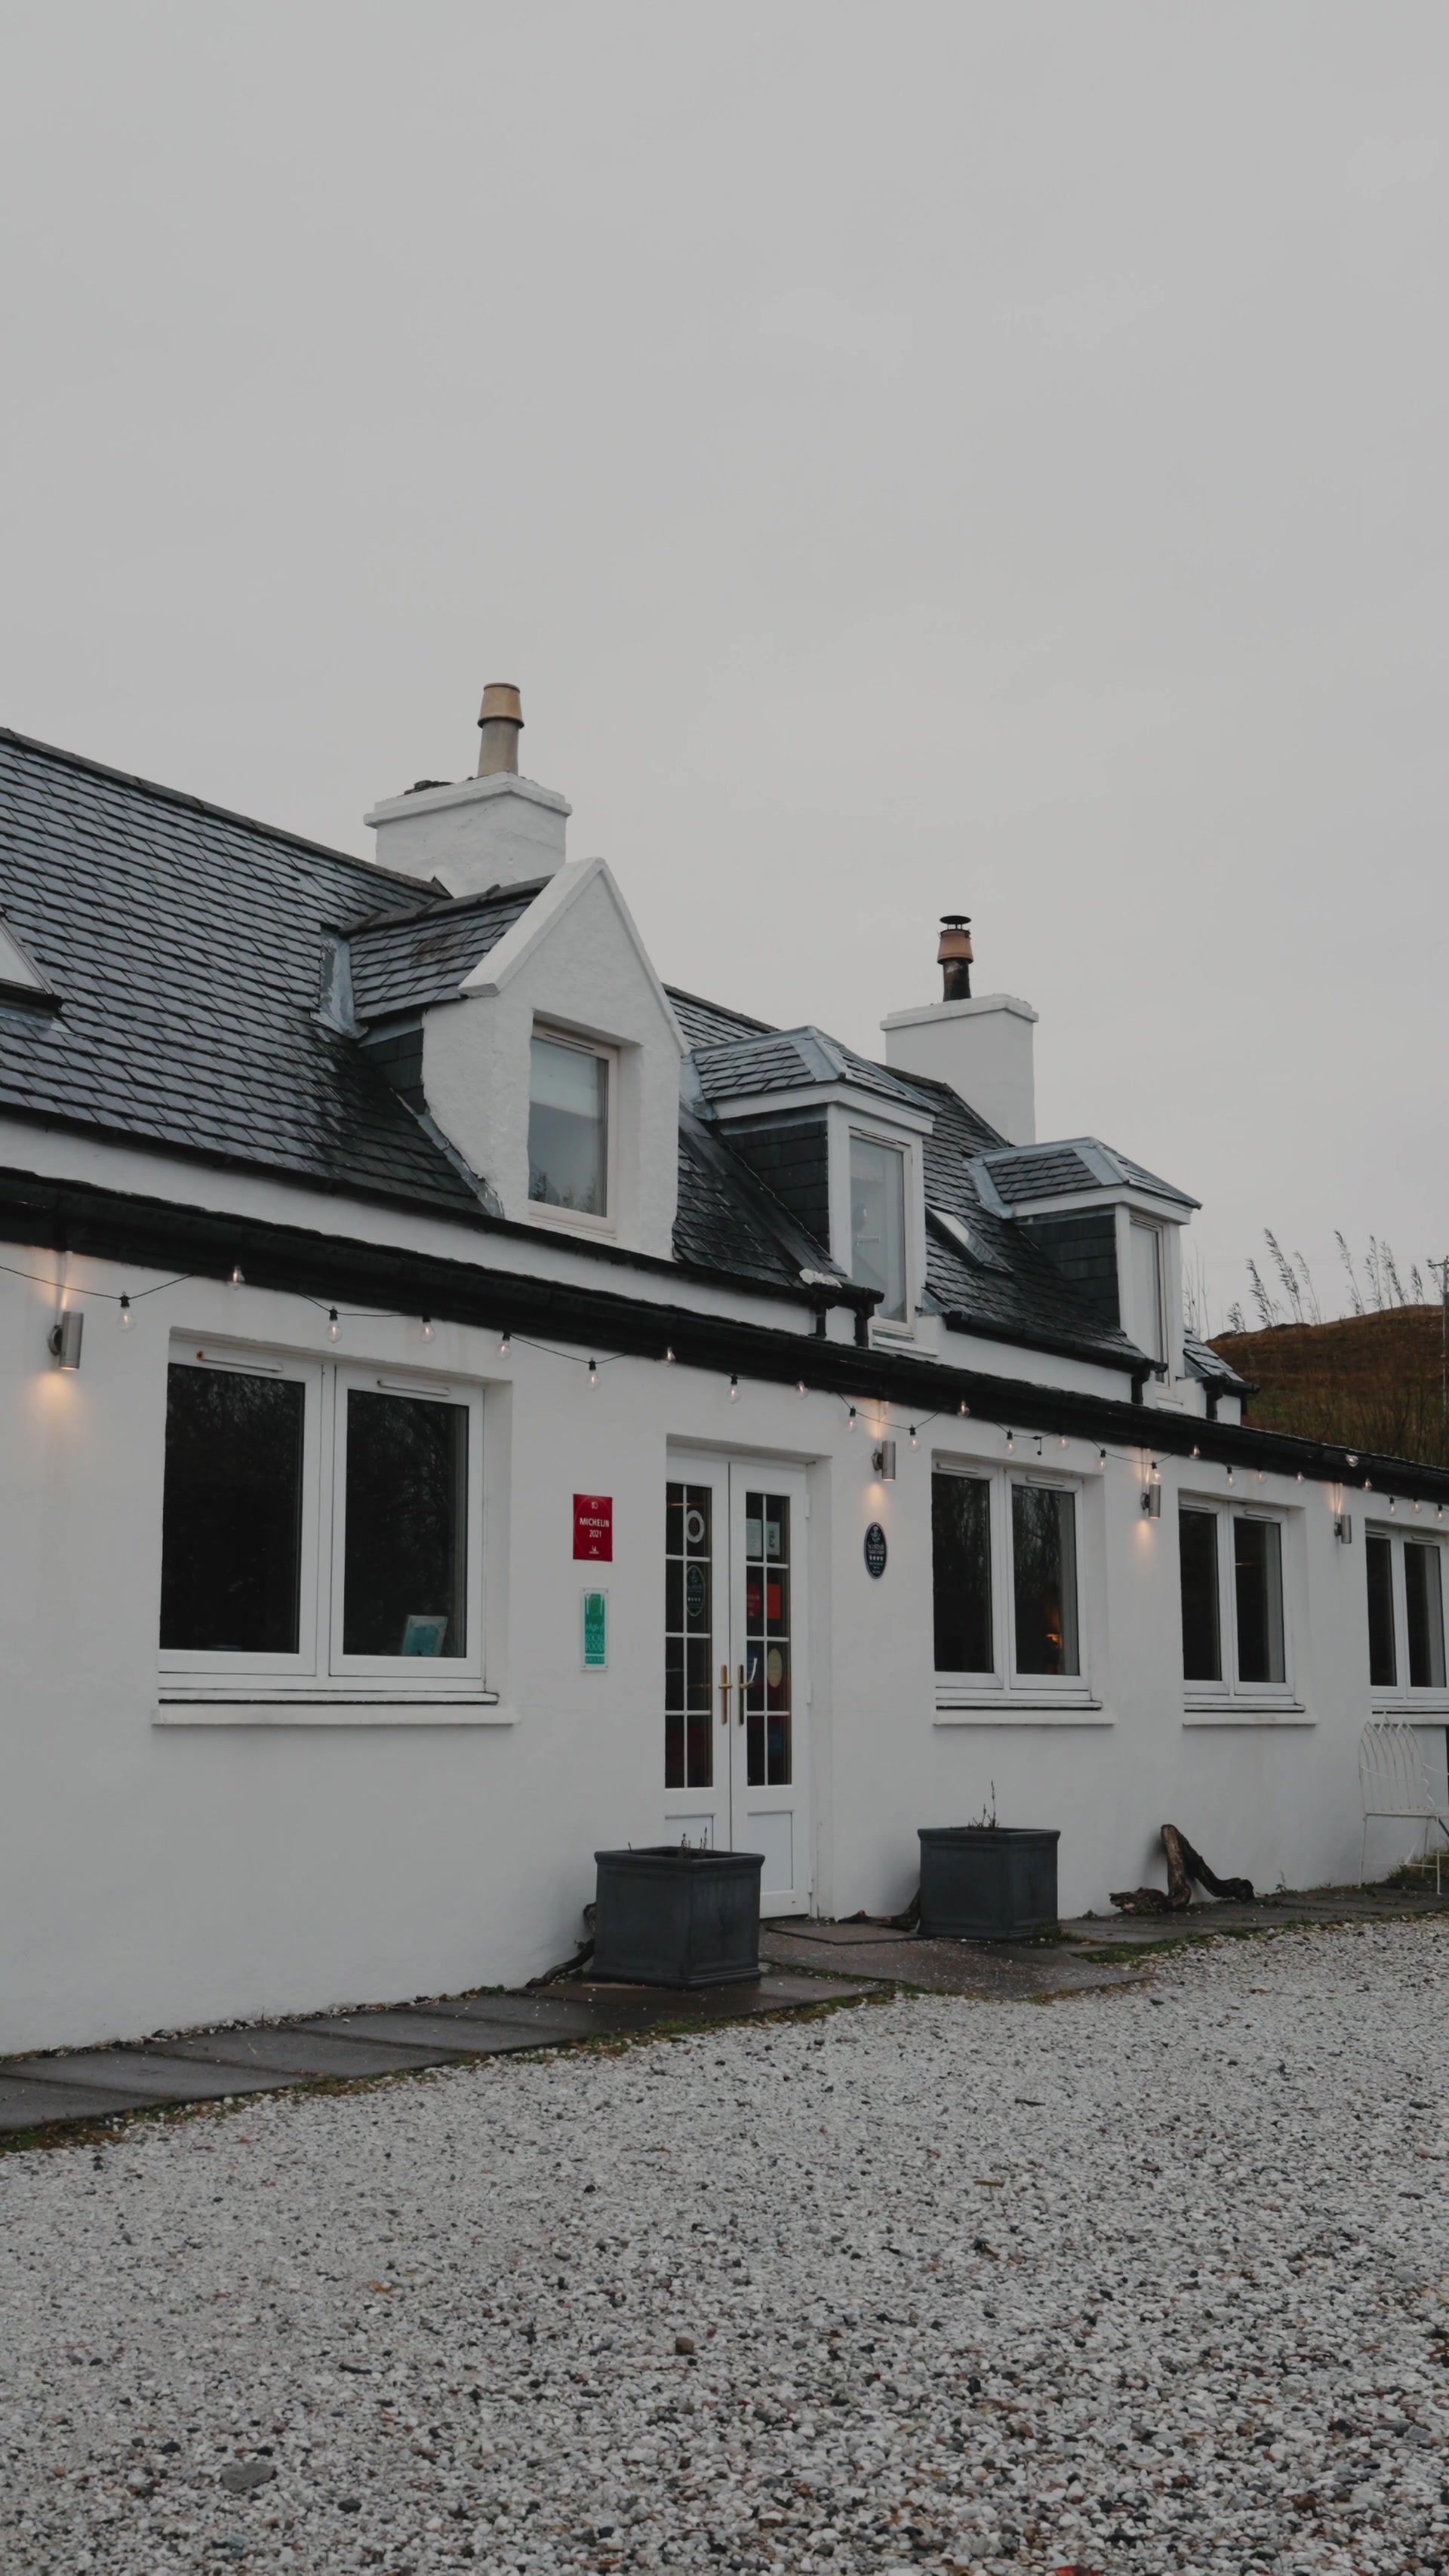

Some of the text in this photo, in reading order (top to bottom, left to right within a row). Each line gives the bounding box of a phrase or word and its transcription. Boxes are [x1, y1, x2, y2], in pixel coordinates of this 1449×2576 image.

[579, 1517, 610, 1527] MICHELIN
[589, 1529, 601, 1538] 2021
[586, 1643, 605, 1652] FOOD
